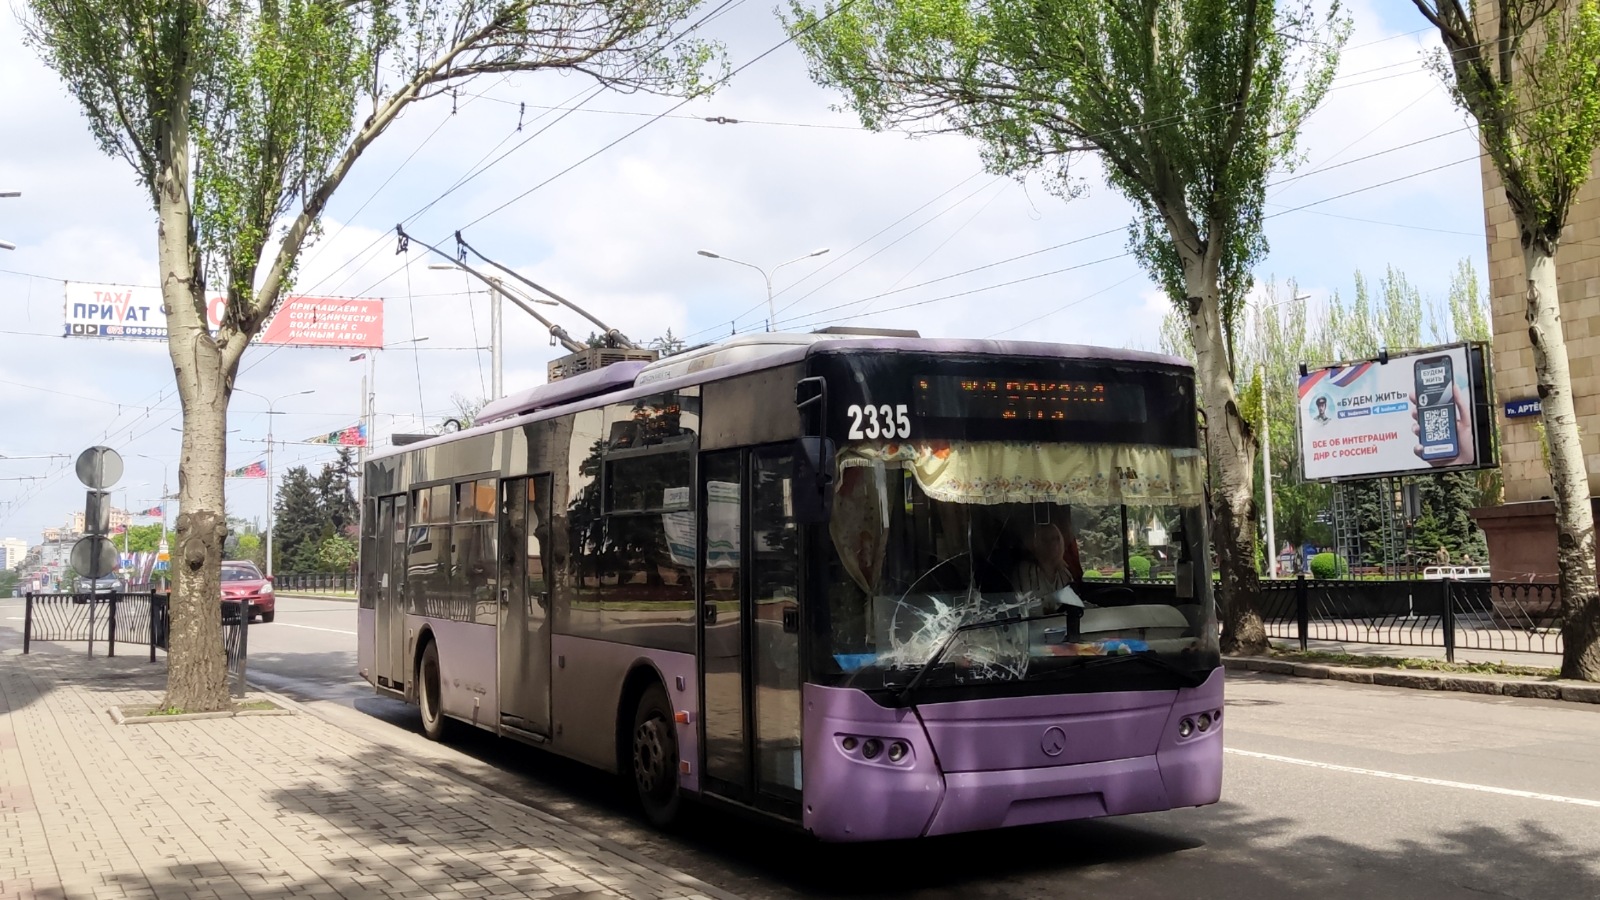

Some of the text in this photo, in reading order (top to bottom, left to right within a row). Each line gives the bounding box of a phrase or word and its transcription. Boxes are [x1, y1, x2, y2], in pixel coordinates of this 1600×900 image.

[289, 302, 369, 313] ПРИГЛАШАЕМ К
[289, 312, 378, 323] СОТРУДНИЧЕСТВУ
[289, 321, 358, 331] ВОДИТЕЛЕЙ С
[288, 330, 367, 341] ЛИЧНЫМ АВТО!
[1337, 392, 1408, 407] «БУДЕМ ЖИТЬ»
[847, 404, 912, 440] 2335
[1312, 432, 1398, 448] ВСЕ ОБ ИНТЕГРАЦИИ
[1313, 445, 1378, 462] ДНР С РОССИЕЙ
